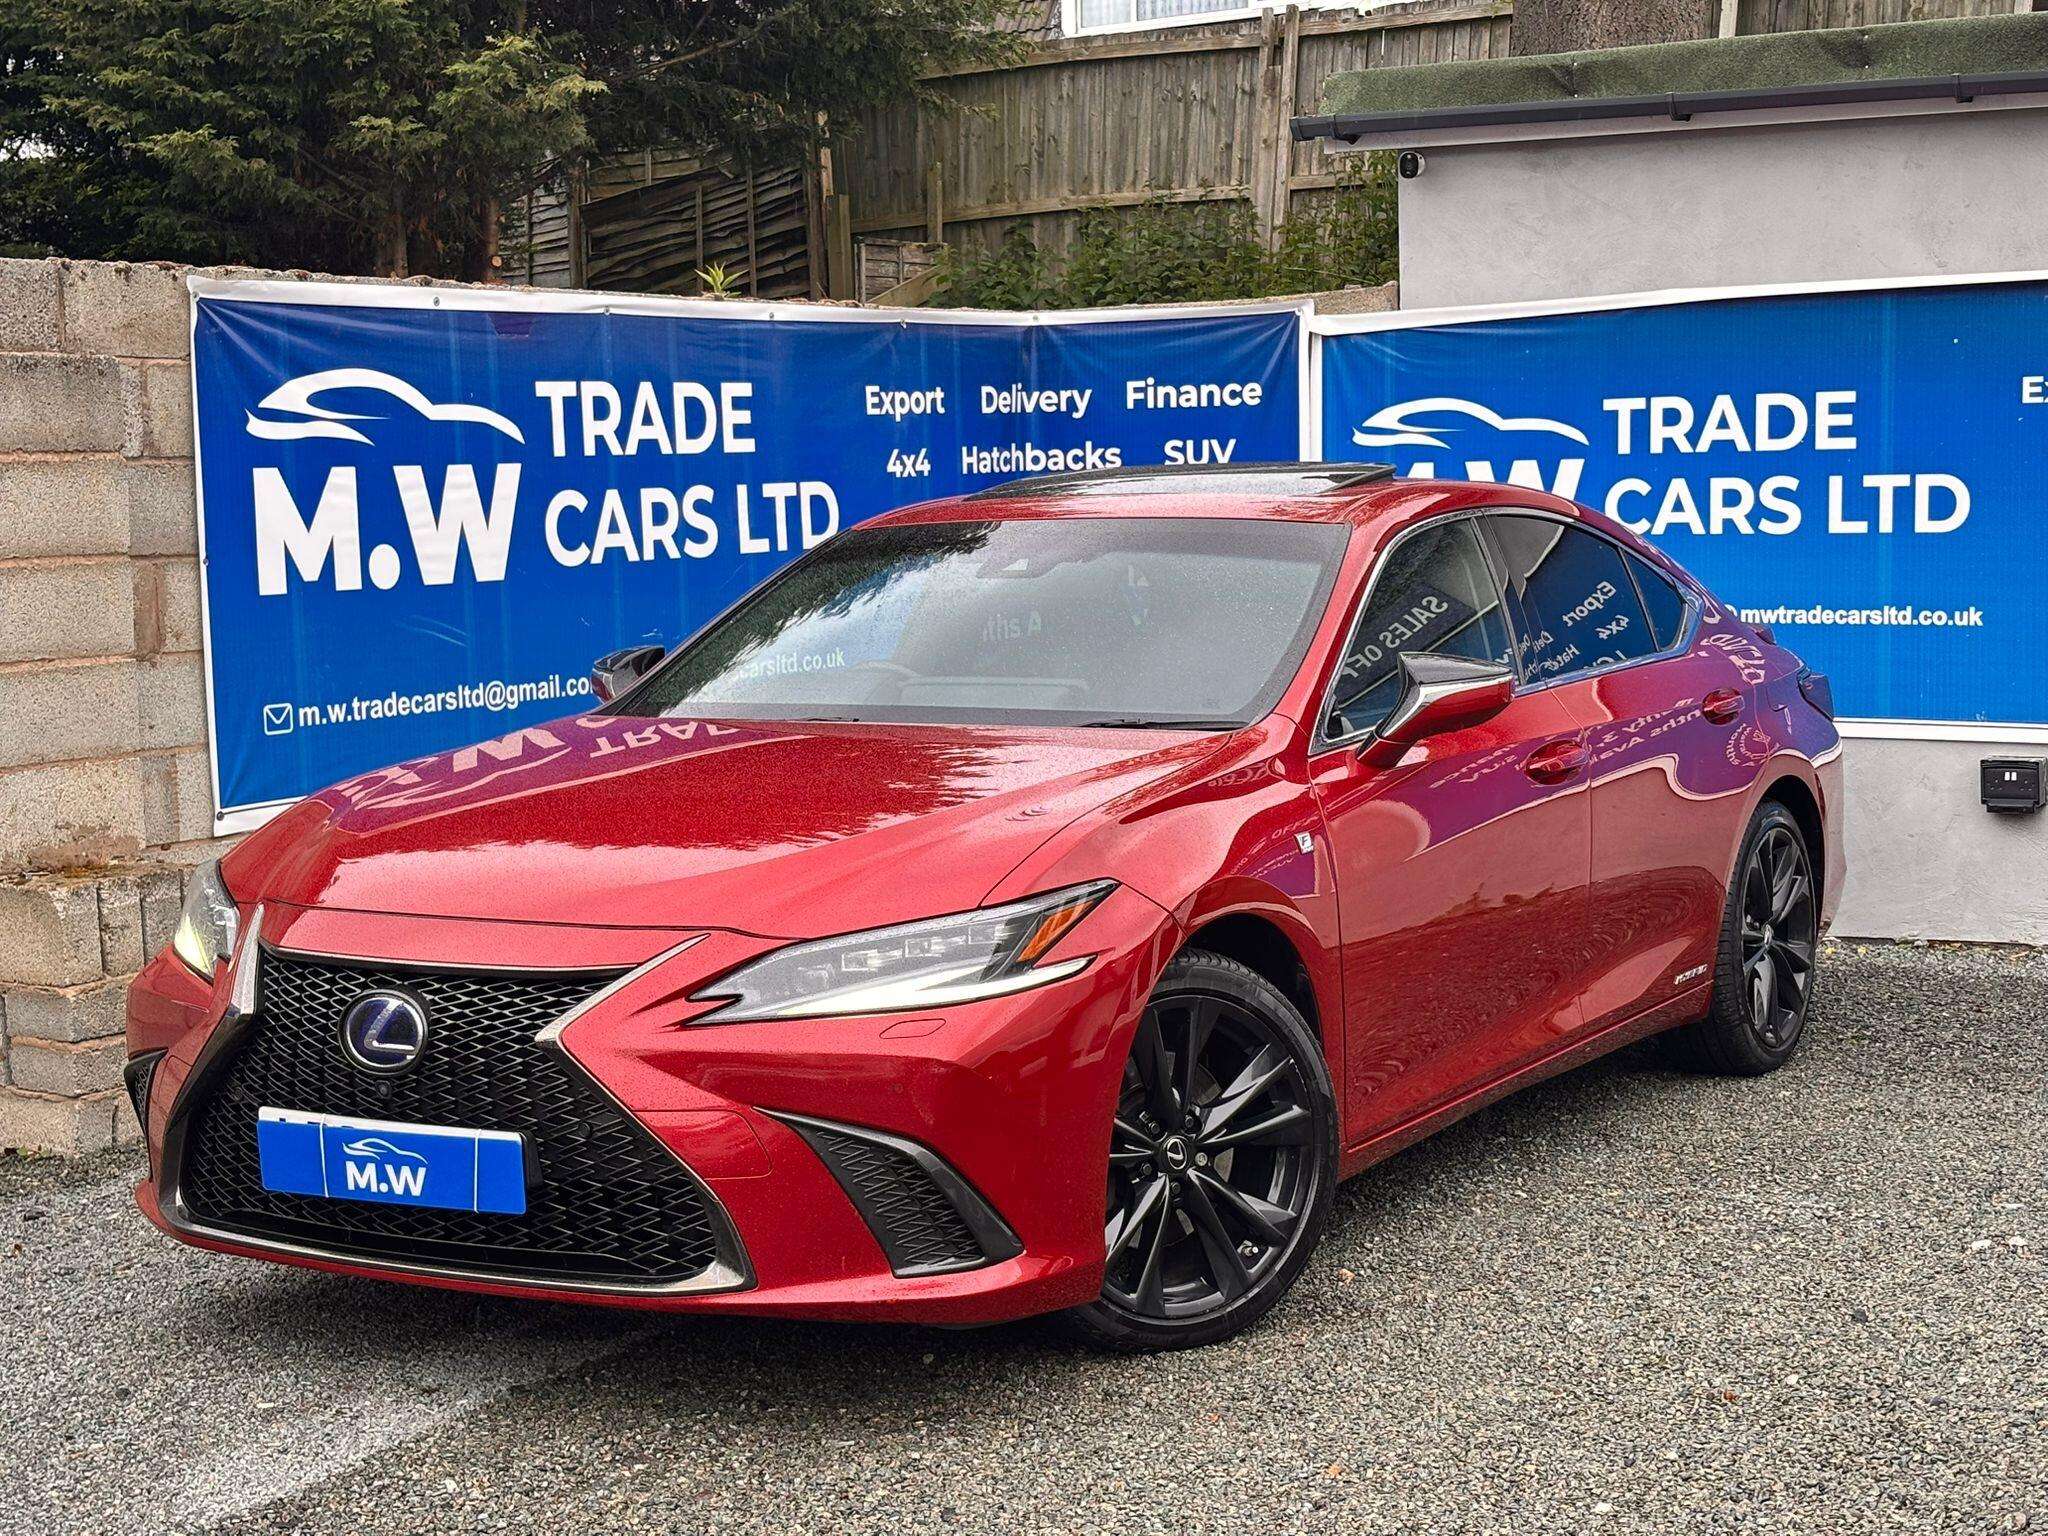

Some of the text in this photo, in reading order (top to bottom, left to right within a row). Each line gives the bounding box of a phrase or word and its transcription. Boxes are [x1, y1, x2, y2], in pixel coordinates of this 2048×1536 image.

[535, 379, 756, 458] TRADE
[865, 377, 1263, 421] Export Delivery Finance
[1602, 389, 1858, 455] TRADE
[885, 437, 1237, 478] 4x4 Hatchbacks SUV
[252, 461, 523, 597] M.W
[543, 480, 840, 568] CARS LTD
[1603, 476, 1803, 536] CARS
[1827, 472, 1972, 535] LTD
[1740, 604, 1985, 627] mwtradecarsltd.co.uk
[298, 674, 594, 728] m.w.tradecarsltd@gmail.co
[344, 1160, 428, 1198] M.W
